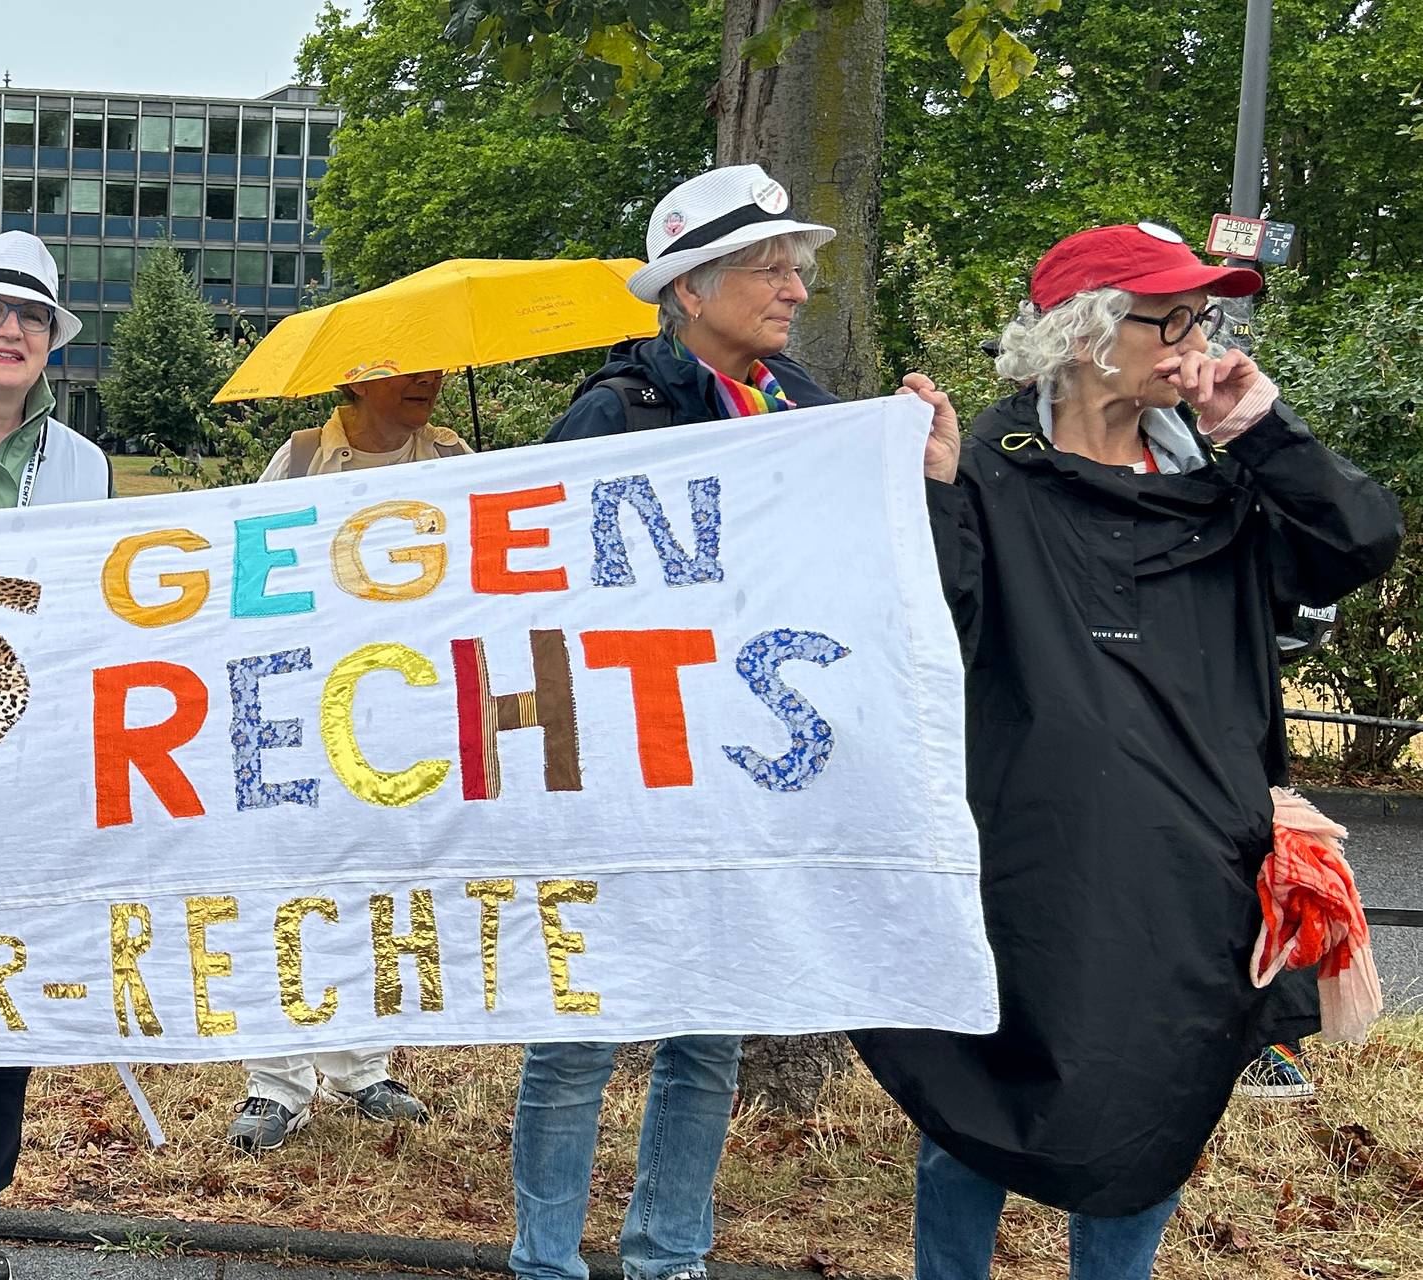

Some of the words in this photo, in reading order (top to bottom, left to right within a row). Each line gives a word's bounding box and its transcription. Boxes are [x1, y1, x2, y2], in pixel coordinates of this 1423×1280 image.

[1226, 220, 1252, 232] H300
[1233, 325, 1250, 336] 13A
[21, 471, 33, 507] RECHTS
[101, 474, 725, 628] GEGEN
[93, 627, 852, 829] RECHTS
